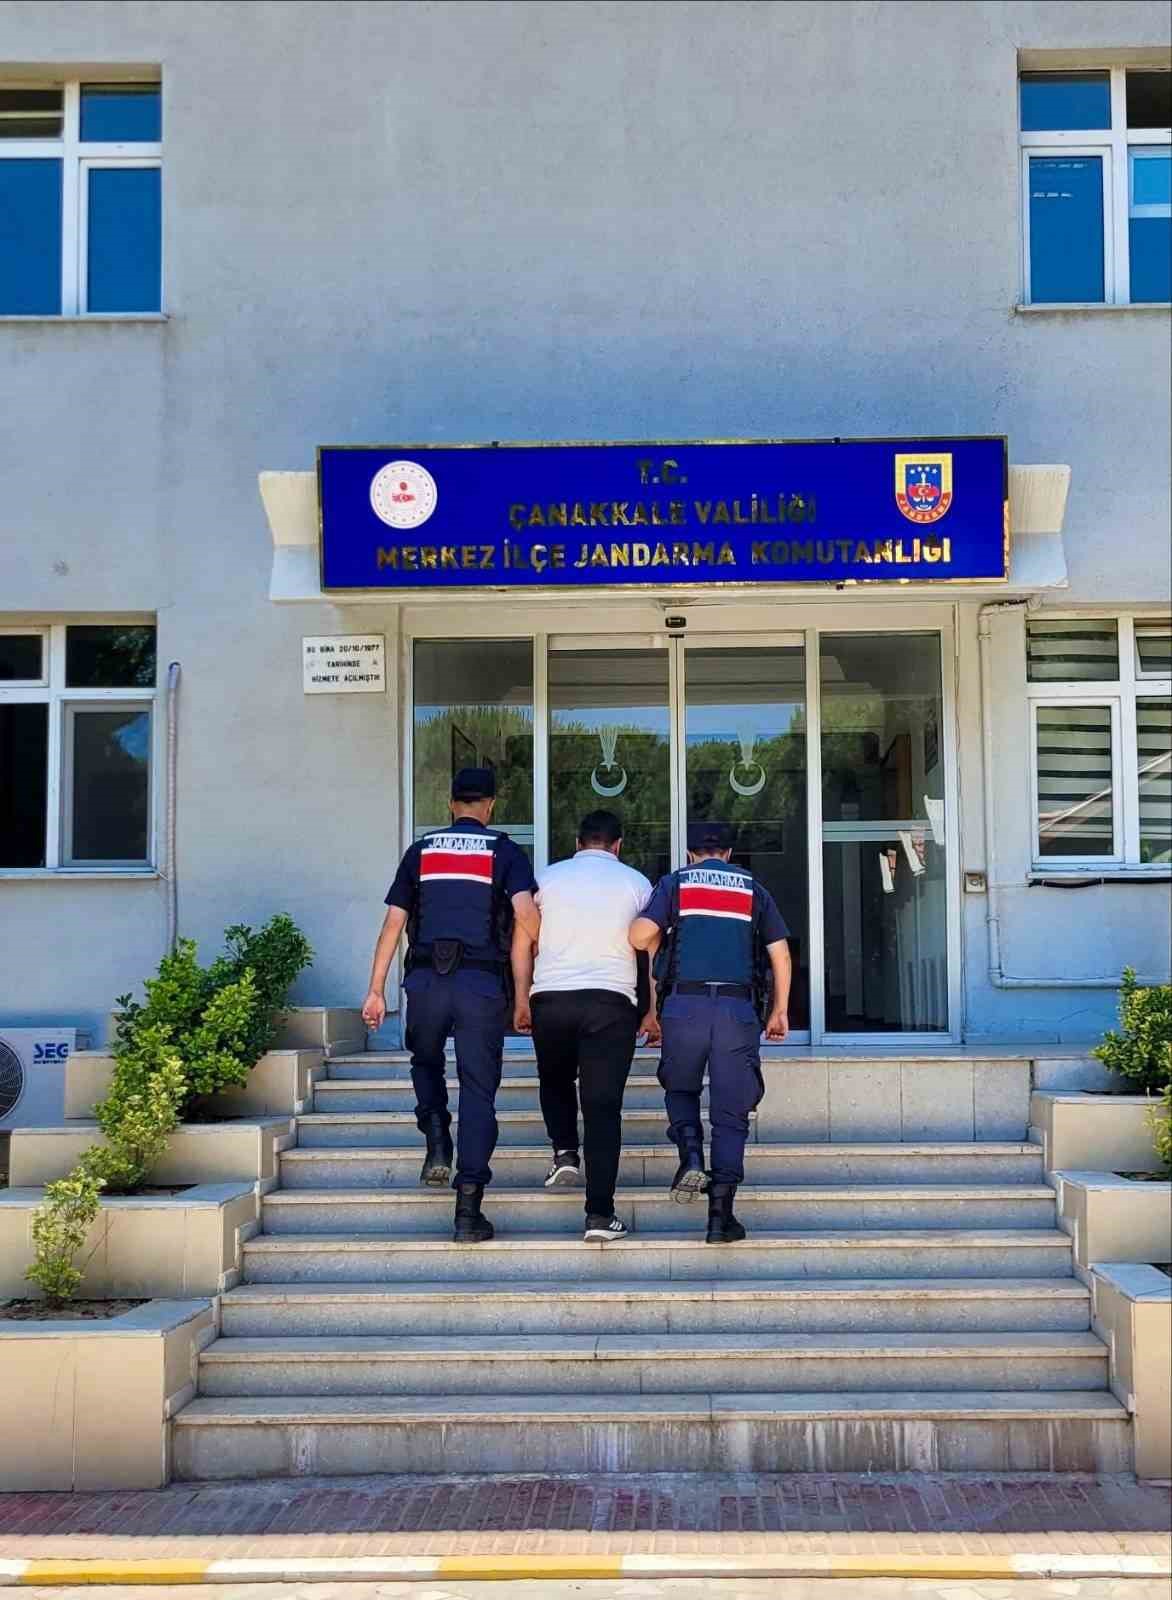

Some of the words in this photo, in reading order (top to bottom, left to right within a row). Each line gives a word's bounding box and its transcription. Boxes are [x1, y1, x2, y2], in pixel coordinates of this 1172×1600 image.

[637, 459, 688, 484] T.C.
[508, 501, 687, 531] ÇANAKKALE
[376, 545, 496, 570] MERKEZ
[503, 537, 566, 573] İLÇE
[573, 540, 737, 568] JANDARMA
[751, 534, 952, 567] KOMUTANLIĞI
[428, 837, 487, 850] JANDARMA
[685, 871, 745, 889] JANDARMA
[33, 1043, 69, 1058] SEG
